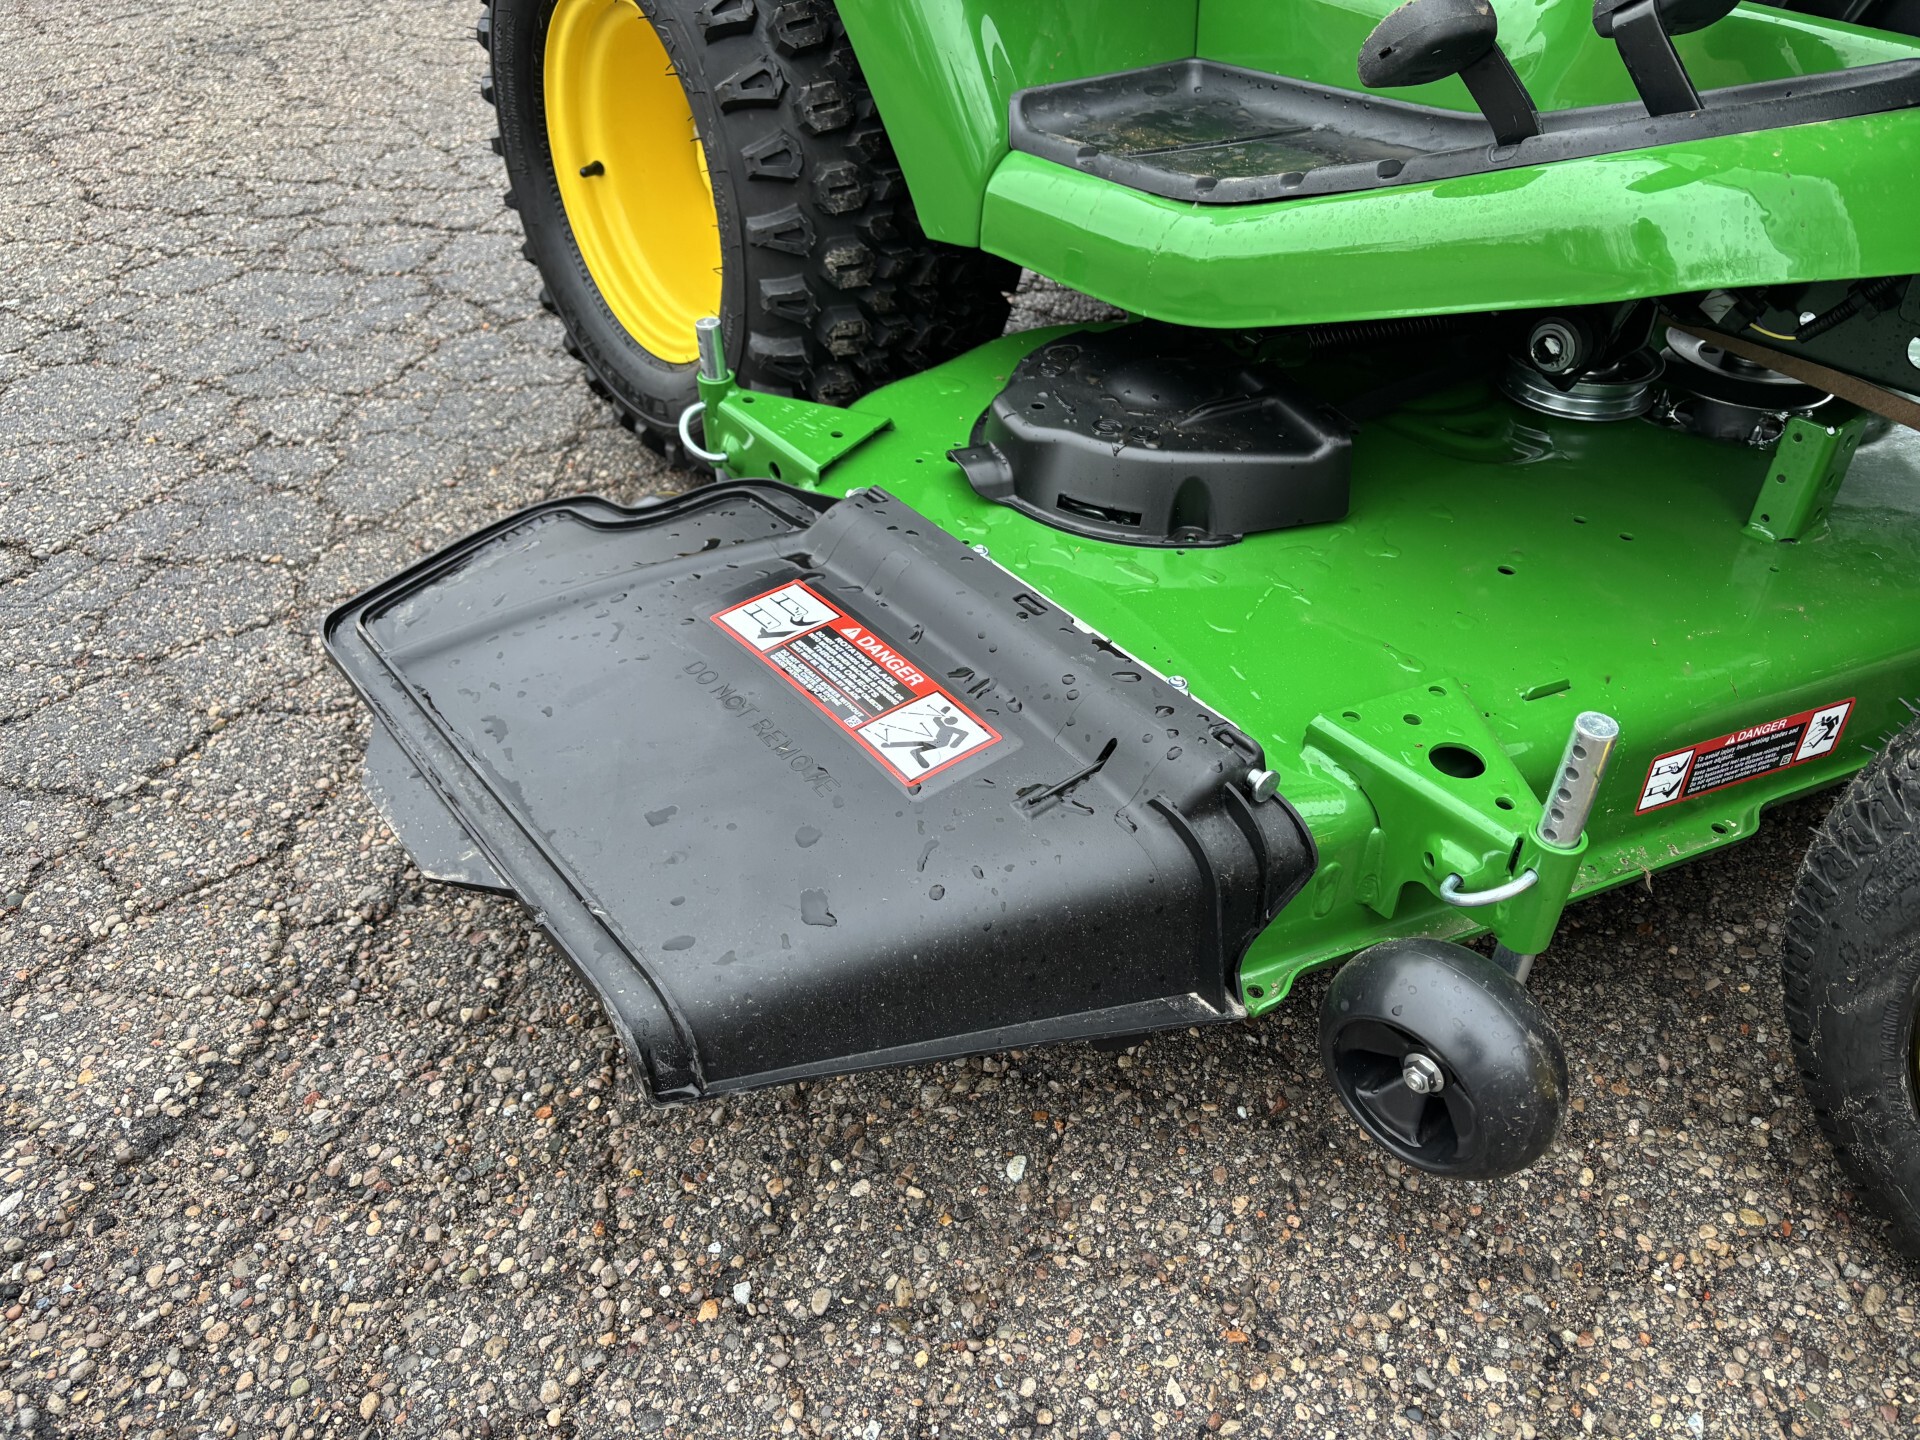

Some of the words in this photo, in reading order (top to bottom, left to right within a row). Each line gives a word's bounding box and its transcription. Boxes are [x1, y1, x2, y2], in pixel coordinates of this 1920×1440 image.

[769, 654, 788, 667] GRASS
[784, 666, 808, 685] CATCHER
[810, 688, 829, 702] PLACE
[774, 651, 802, 673] DISCHARGE
[799, 672, 817, 685] CHUTE
[821, 690, 842, 706] ENTIRE
[789, 642, 803, 652] THAT
[800, 651, 813, 660] MAY
[815, 664, 838, 681] THROWN
[841, 685, 861, 700] BLADE
[794, 639, 814, 654] BEFORE
[827, 666, 845, 679] CLEAR
[841, 677, 858, 689] AREA
[860, 692, 884, 711] OBJECTS
[807, 632, 821, 642] INTO
[818, 641, 838, 655] MOWER
[834, 654, 851, 666] WHEN
[848, 664, 872, 683] MACHINE
[874, 686, 900, 705] RUNNING
[812, 644, 846, 670] THROWN
[842, 669, 880, 698] OBJECTS
[822, 636, 835, 645] NOT
[831, 644, 844, 652] PUT
[840, 651, 860, 665] HANDS
[864, 669, 880, 680] FEET
[876, 679, 896, 694] UNDER
[893, 692, 905, 700] OR
[834, 637, 872, 666] ROTATING
[869, 665, 898, 686] BLADE
[854, 635, 926, 686] DANGER
[787, 655, 800, 664] NOT
[796, 663, 822, 682] OPERATE
[818, 681, 840, 698] MOWER
[837, 696, 864, 717] WITHOUT
[683, 660, 719, 685] DO
[709, 682, 760, 717] NOT
[748, 717, 841, 798] REMOVE
[1704, 750, 1720, 759] avoid
[1719, 745, 1736, 756] injury
[1735, 741, 1749, 750] from
[1748, 735, 1770, 747] rotating
[1770, 730, 1788, 740] blades
[1788, 726, 1799, 734] and
[1736, 718, 1787, 742] DANGER
[1687, 785, 1700, 793] chute
[1706, 779, 1720, 787] entire
[1720, 775, 1734, 783] grass
[1734, 769, 1751, 778] catcher
[1690, 774, 1704, 782] Keep
[1703, 766, 1729, 778] bystanders
[1744, 756, 1764, 765] distance
[1692, 768, 1706, 777] Keep
[1705, 764, 1720, 772] hands
[1738, 754, 1751, 763] away
[1762, 746, 1780, 756] rotating
[1693, 758, 1713, 769] thrown
[1704, 773, 1723, 783] operate
[1723, 768, 1739, 777] mower
[1739, 762, 1757, 772] without
[1756, 756, 1779, 767] discharge
